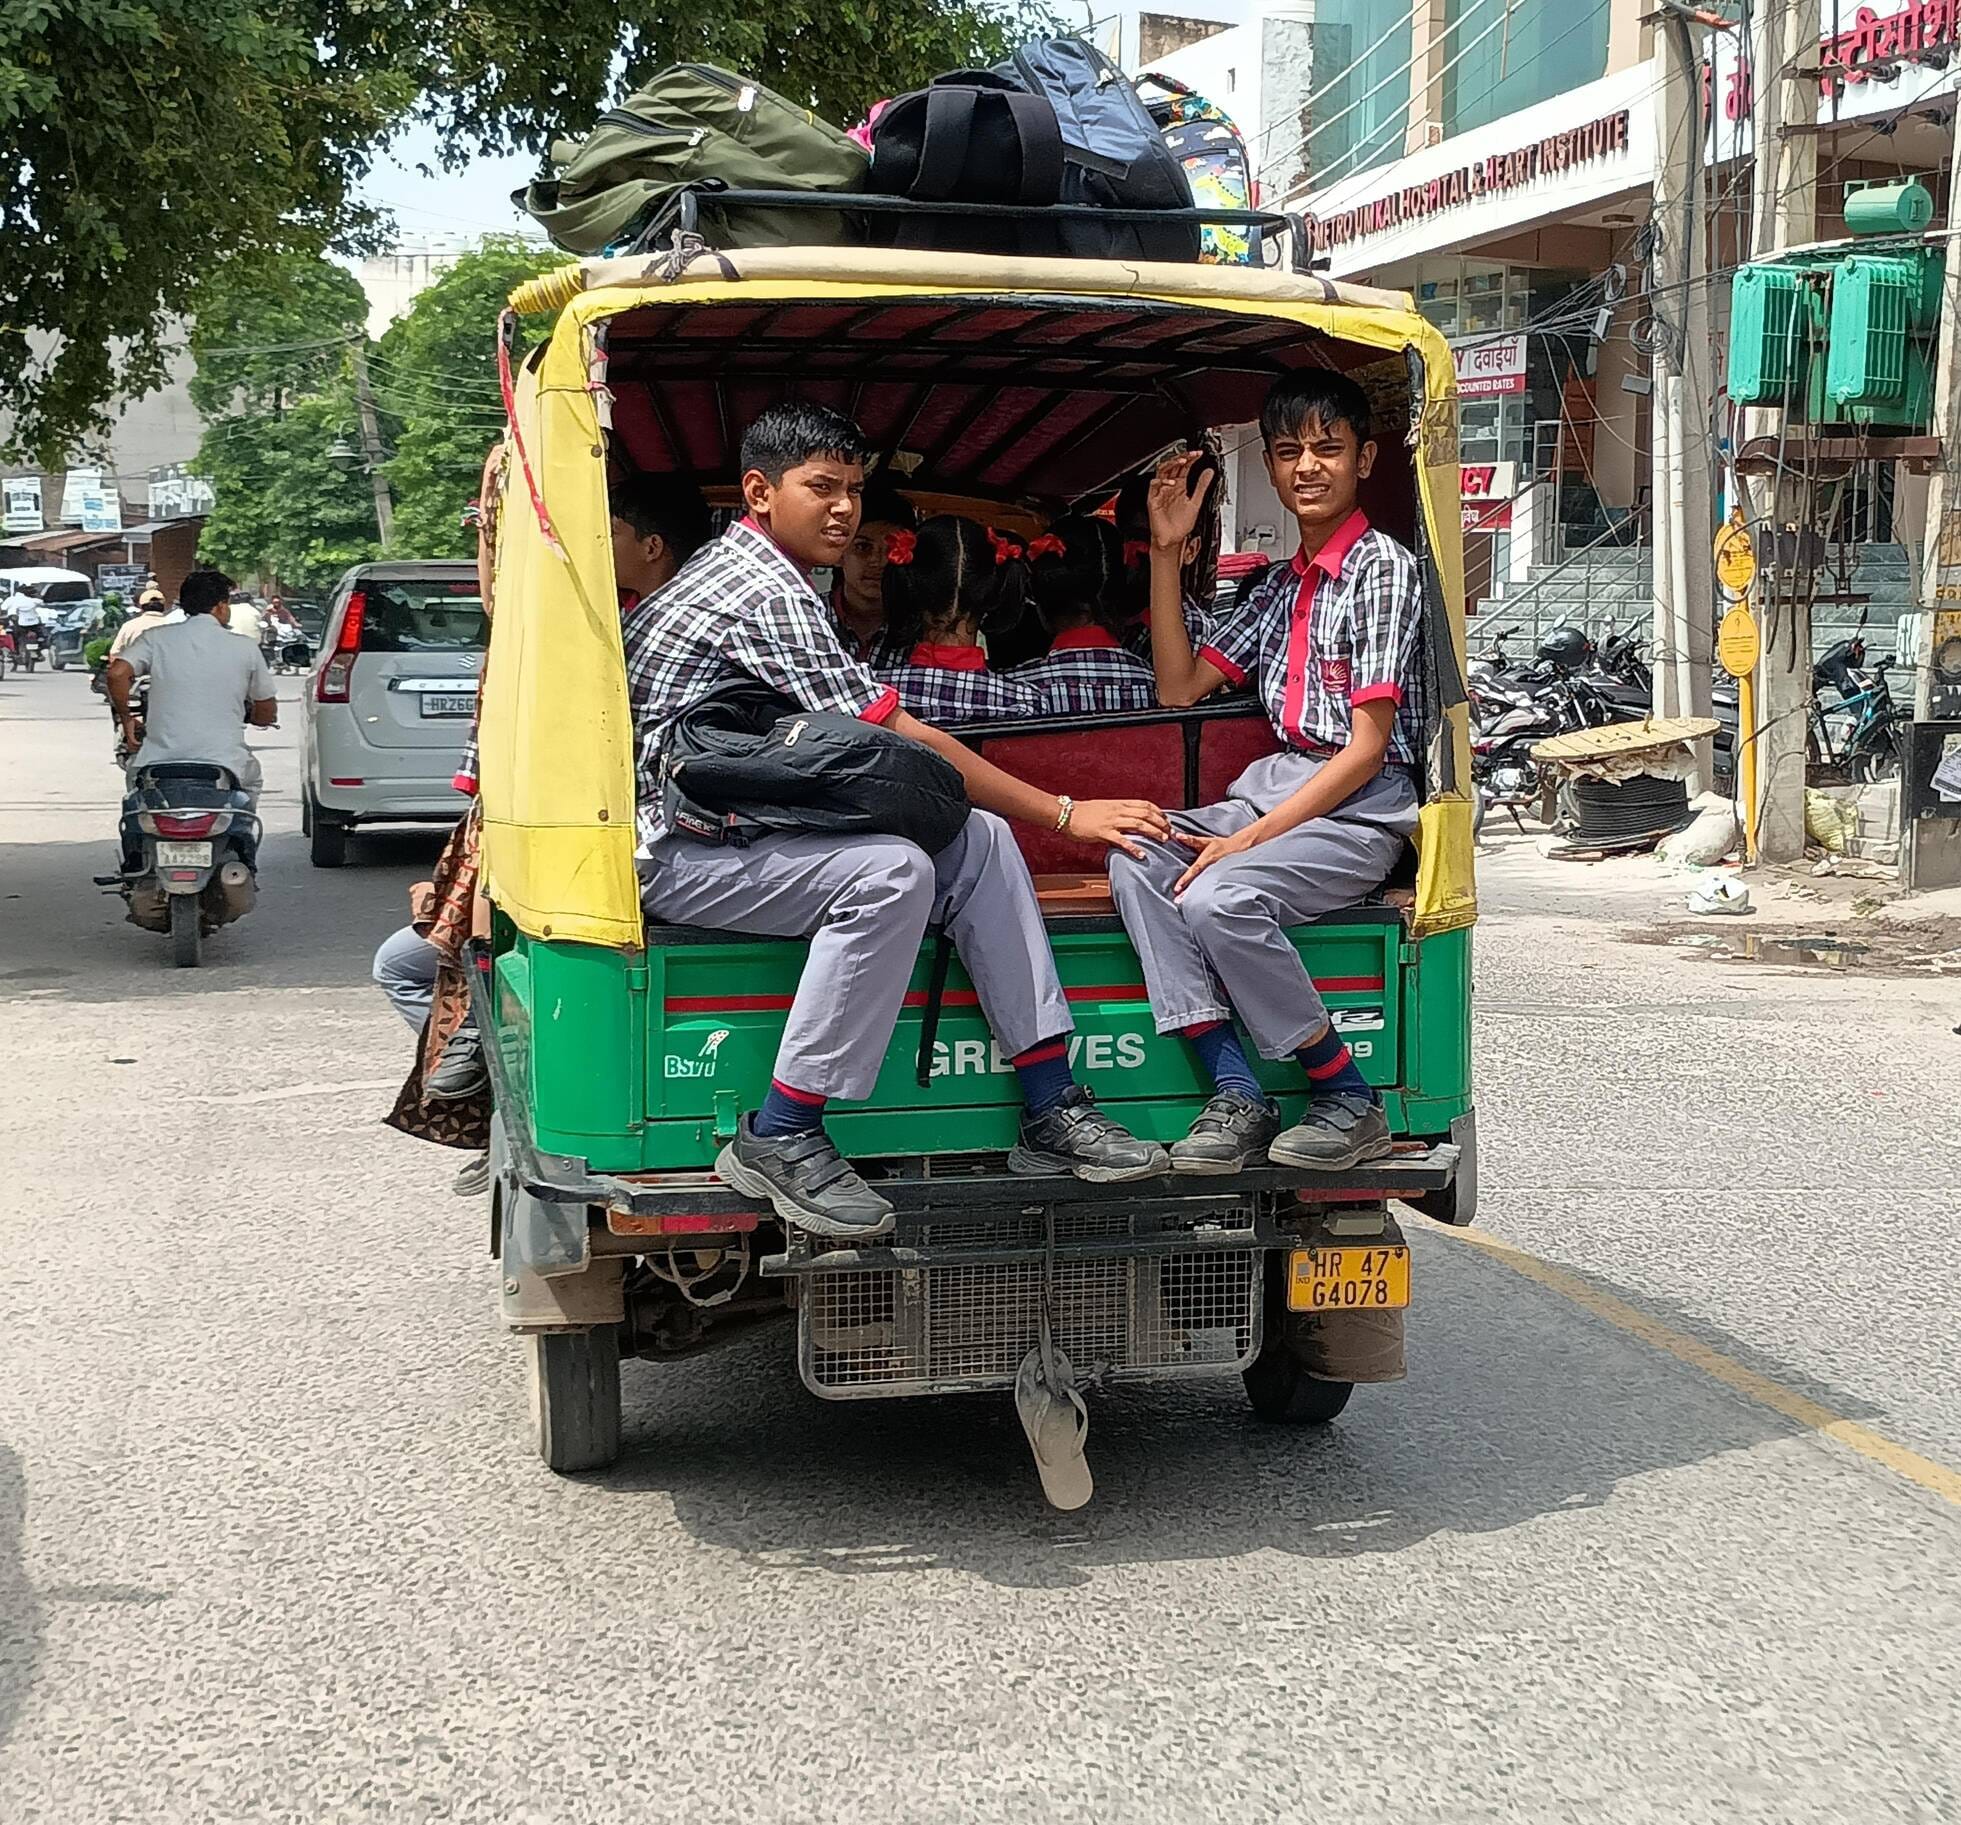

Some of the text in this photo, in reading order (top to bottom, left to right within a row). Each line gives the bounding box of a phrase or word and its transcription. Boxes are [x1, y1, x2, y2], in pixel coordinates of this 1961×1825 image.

[1313, 109, 1630, 251] METRO UMKAL HOSPITAL & HEART INSTITUTE
[1492, 378, 1515, 391] RATES
[1314, 1251, 1390, 1277] HR 47
[1296, 1276, 1310, 1285] IND
[1312, 1279, 1388, 1307] G4078
